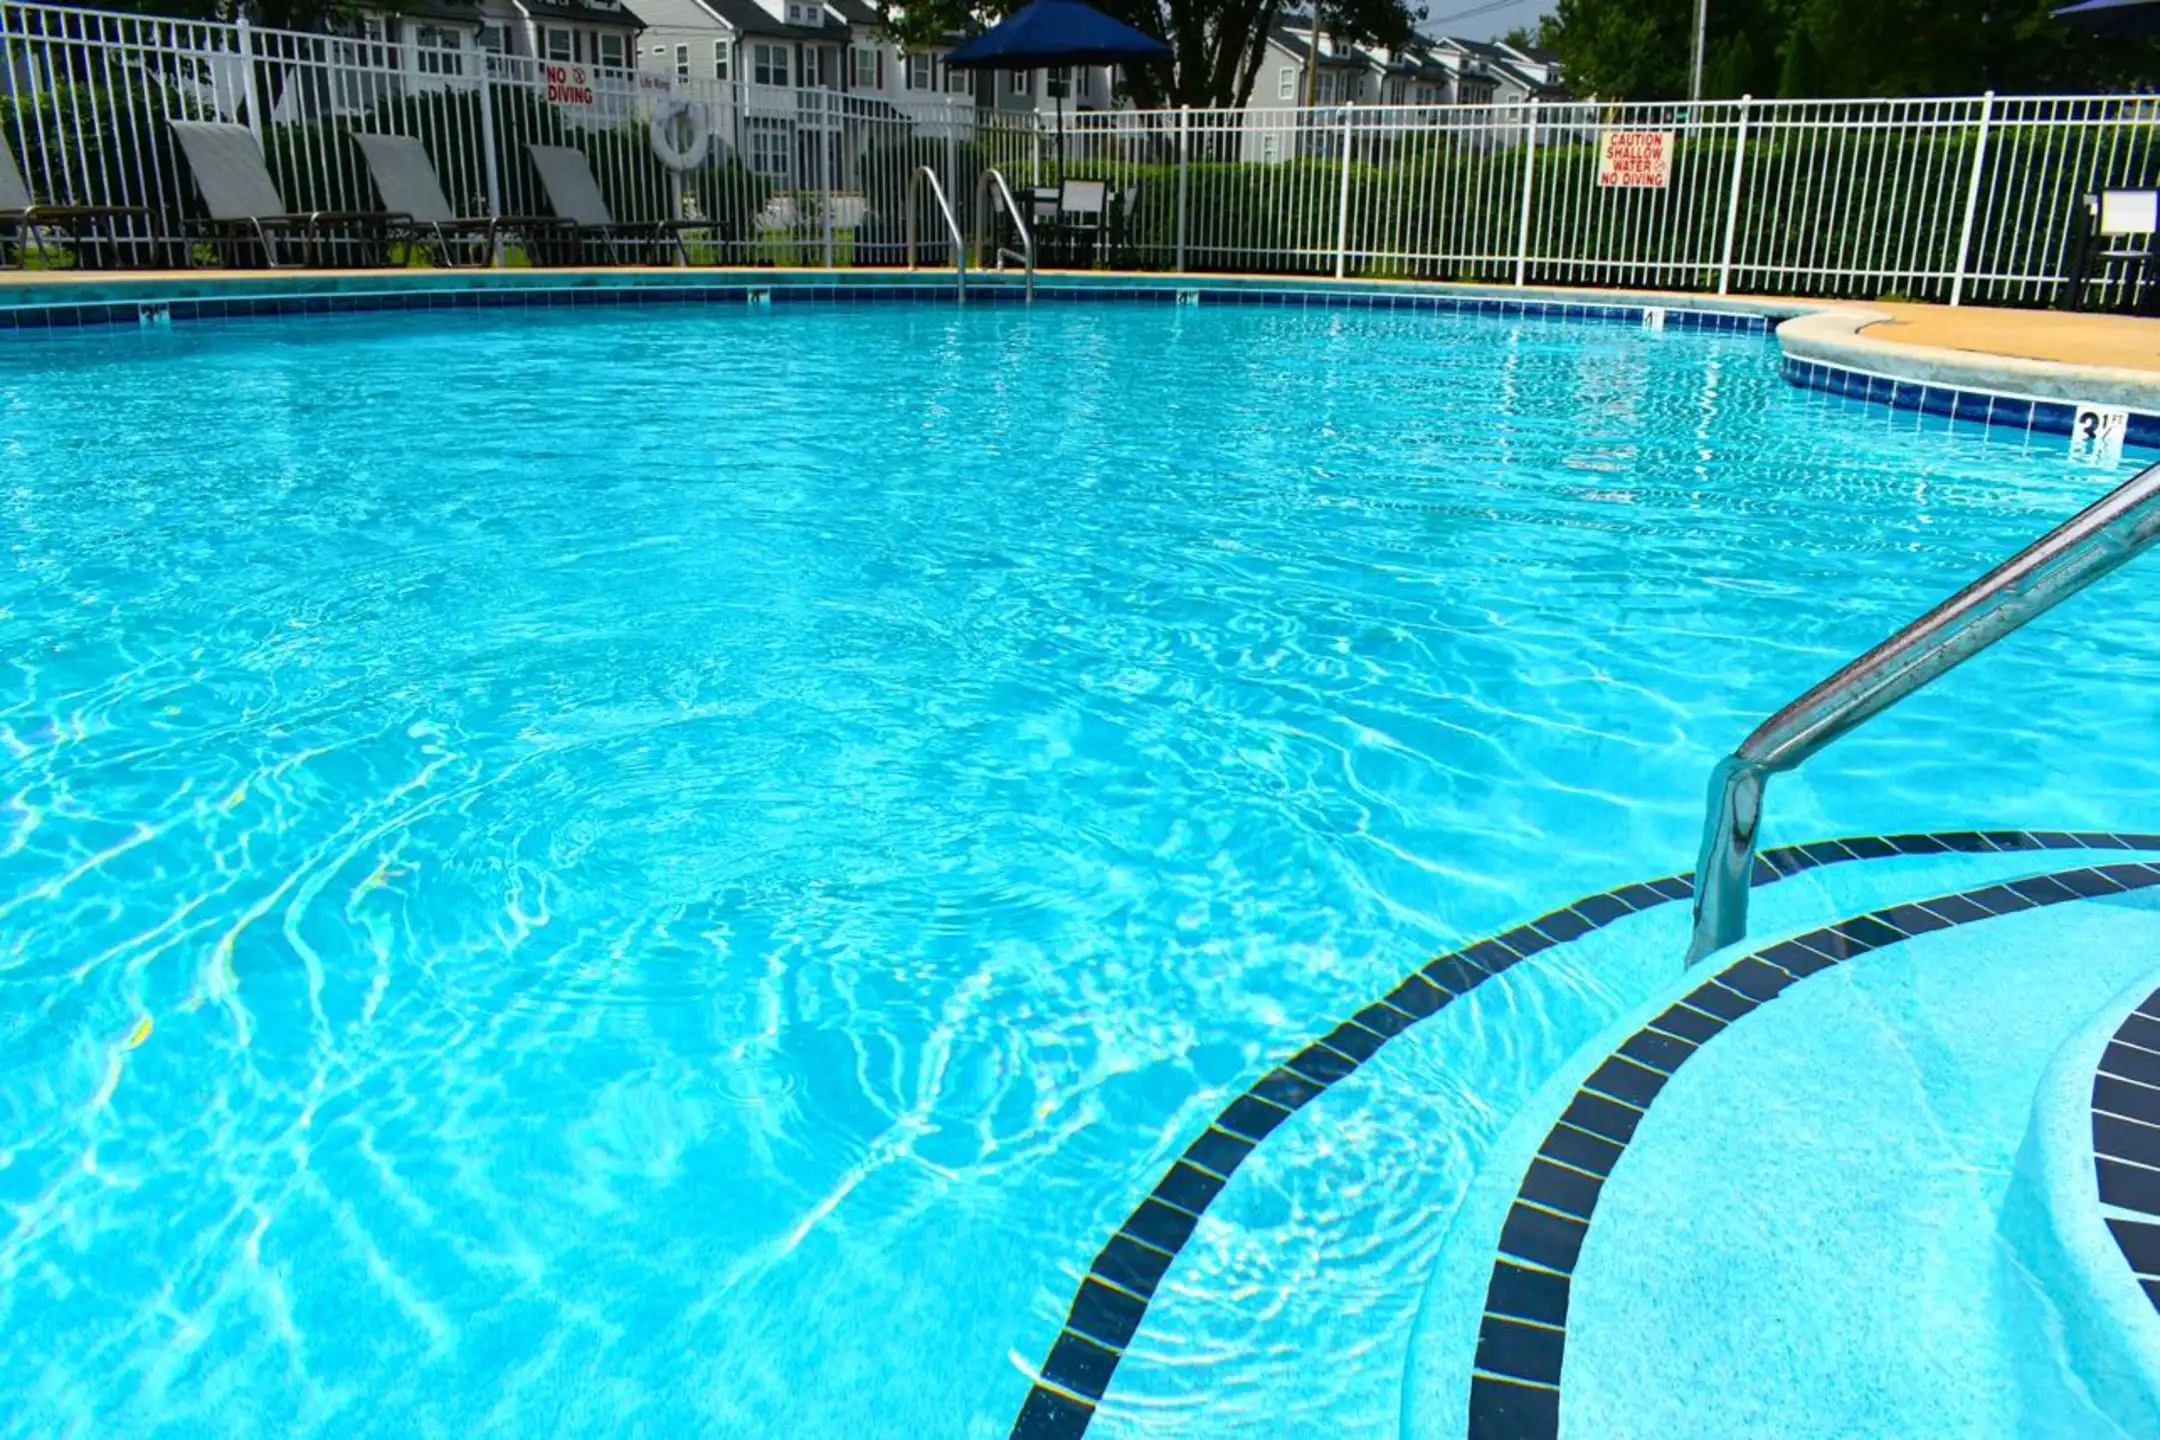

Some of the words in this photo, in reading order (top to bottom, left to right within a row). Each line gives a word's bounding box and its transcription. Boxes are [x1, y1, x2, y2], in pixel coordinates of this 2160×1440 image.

[547, 66, 566, 84] NO
[548, 85, 593, 104] DIVING
[1611, 133, 1663, 146] CAUTION
[1606, 147, 1663, 159] SHALLOW
[1613, 160, 1651, 172] WATER
[1601, 172, 1618, 184] NO
[1622, 173, 1663, 185] DIVING
